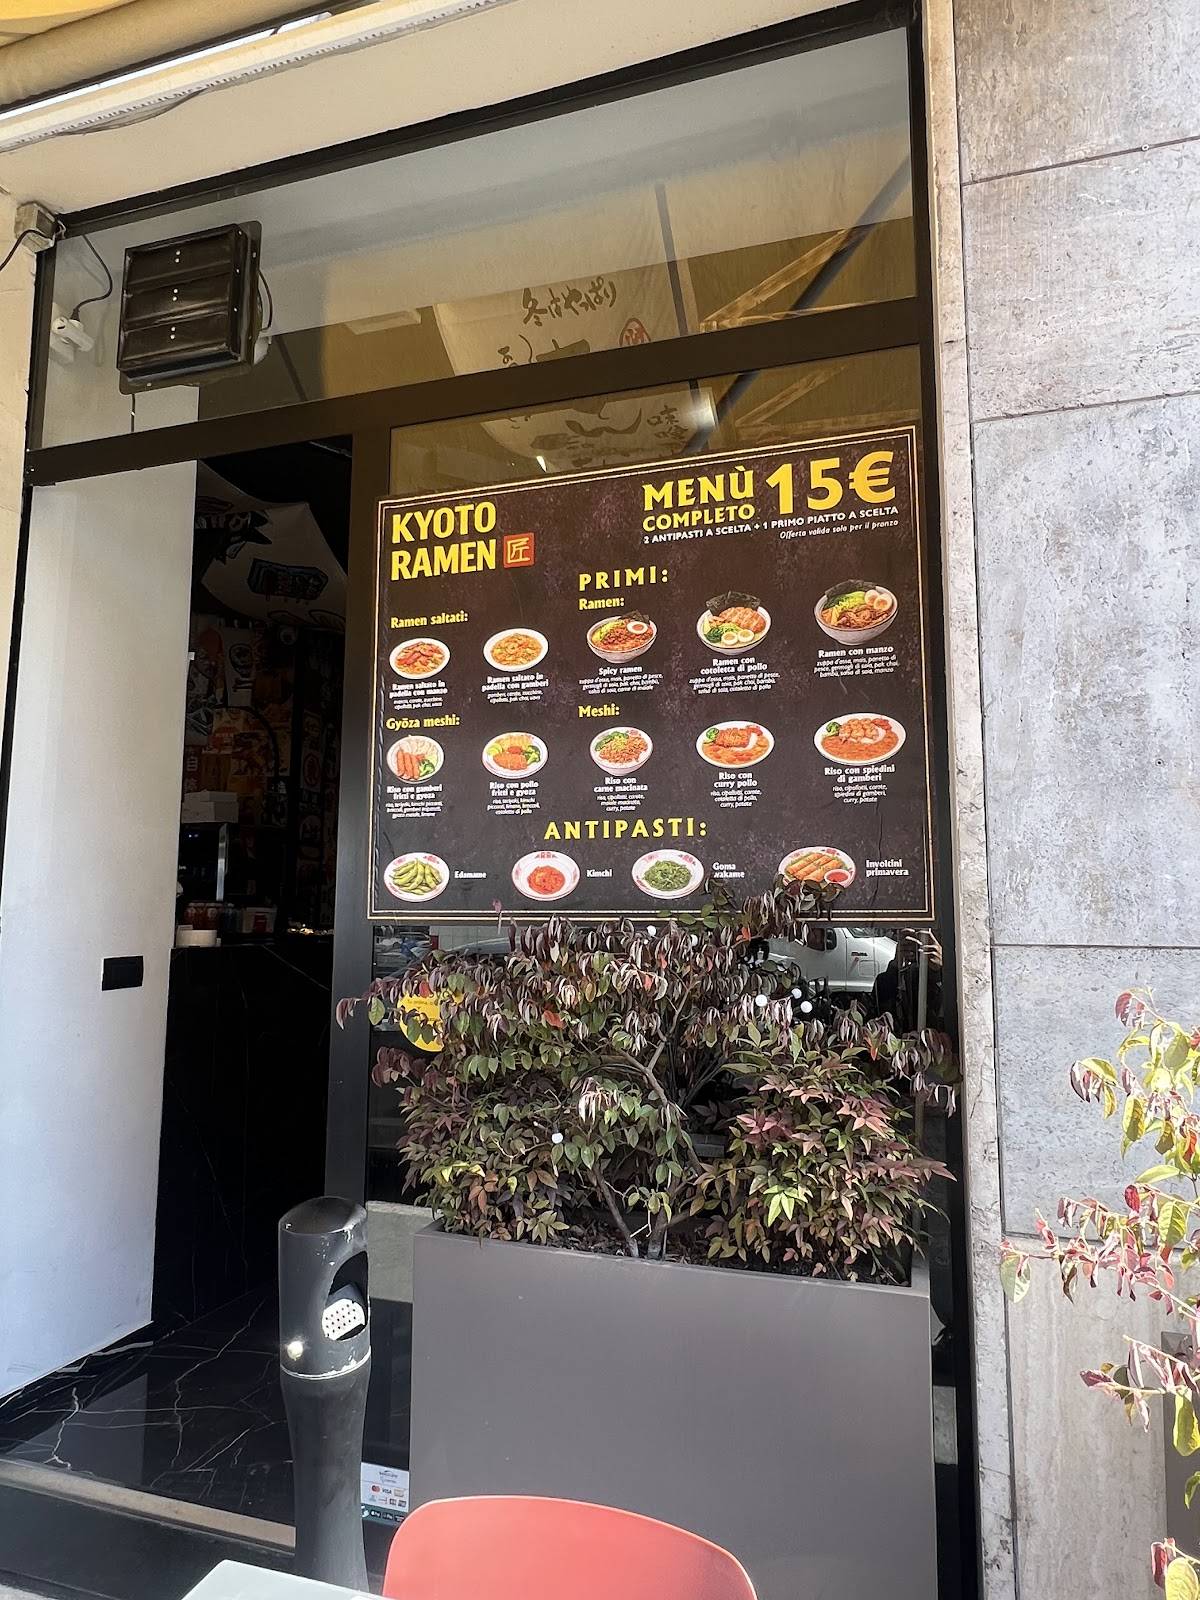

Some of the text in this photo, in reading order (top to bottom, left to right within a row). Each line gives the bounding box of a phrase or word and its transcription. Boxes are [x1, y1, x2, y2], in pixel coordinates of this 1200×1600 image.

[642, 450, 896, 515] MENÙ 15€
[392, 501, 497, 544] KYOTO
[642, 504, 755, 532] COMPLETO
[644, 535, 650, 544] 2
[652, 530, 704, 544] ANTIPASTI
[706, 528, 714, 538] A
[715, 523, 752, 536] SCELTA
[762, 520, 768, 530] 1
[771, 516, 804, 529] PRIMO
[807, 512, 846, 525] PIATTO
[848, 510, 858, 520] A
[860, 506, 899, 519] SCELTA
[780, 519, 899, 540] Offerta valida solo per il pranzo
[505, 535, 532, 566] 匠
[390, 539, 497, 581] RAMEN
[578, 565, 669, 592] PRIMI:
[578, 596, 625, 612] Ramen:
[390, 610, 469, 630] Ramen saltati:
[818, 646, 894, 658] Ramen con manzo
[712, 658, 739, 667] Ramen
[598, 666, 642, 676] Spicy ramen
[700, 663, 768, 675] cotoletta di pollo
[578, 703, 620, 718] Meshi:
[386, 714, 460, 731] Gyōza meshi:
[718, 772, 736, 780] Riso
[824, 767, 843, 776] Riso
[862, 764, 896, 776] spiedini
[490, 782, 505, 790] Riso
[520, 780, 539, 789] pollo
[605, 777, 621, 785] Riso
[737, 779, 758, 788] pollo
[837, 774, 882, 784] di gamberi
[615, 784, 648, 792] macinata
[544, 817, 707, 841] ANTIPASTI:
[712, 862, 736, 871] Goma
[866, 859, 902, 868] Involtini
[586, 868, 613, 878] Kimchi
[866, 868, 909, 878] primavera
